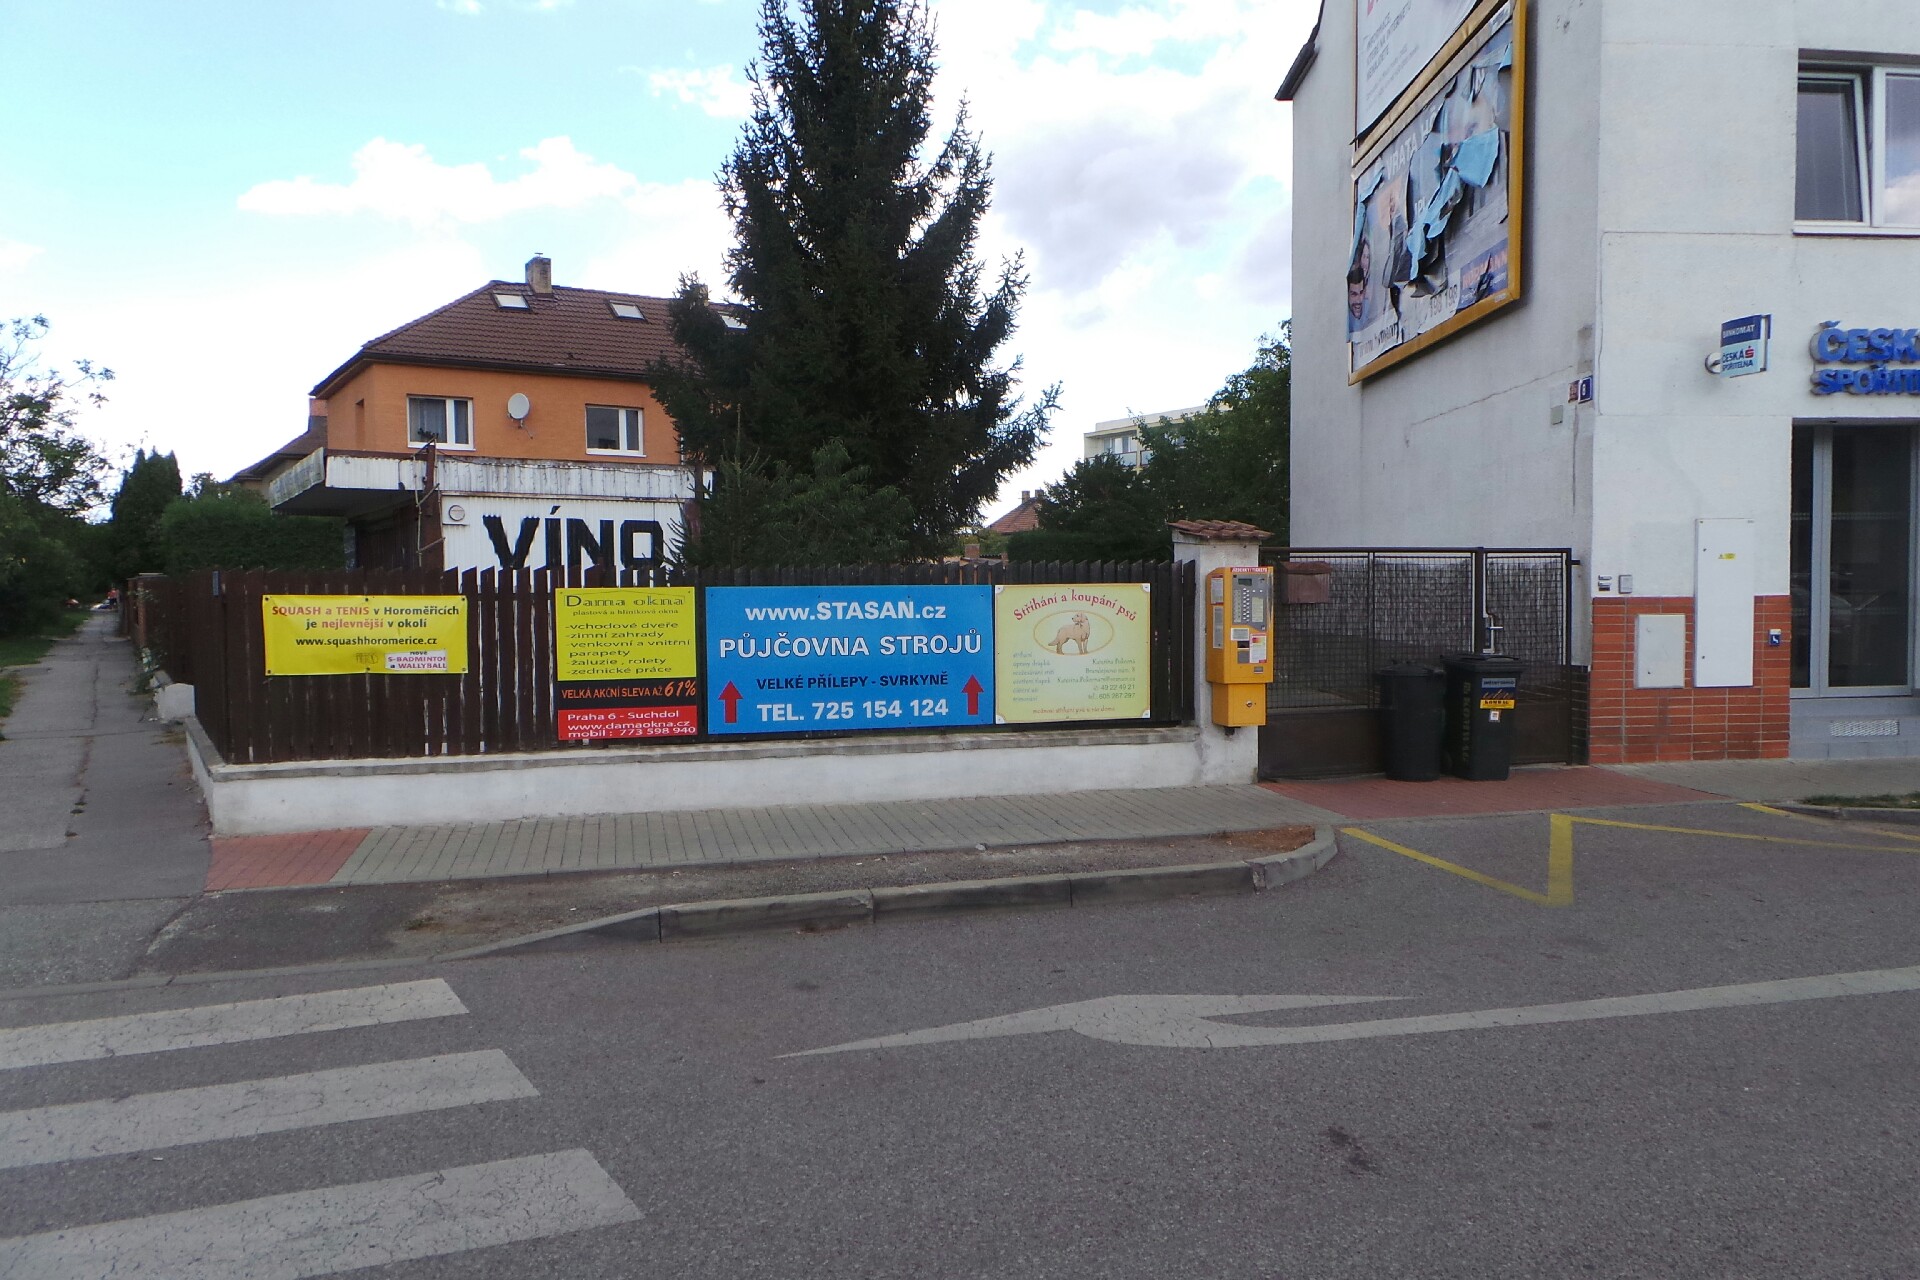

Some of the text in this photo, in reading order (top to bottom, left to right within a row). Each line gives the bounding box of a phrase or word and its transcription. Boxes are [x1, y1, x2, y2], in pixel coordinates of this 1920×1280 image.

[482, 505, 664, 571] VÍNO
[566, 595, 684, 607] Dama okna
[1013, 588, 1137, 621] Stříhání a koupání psů
[272, 606, 321, 616] SQUASH
[336, 606, 370, 615] TENIS
[384, 605, 460, 616] Horoměřicích
[745, 601, 947, 621] www.STASAN.cz
[306, 618, 427, 630] je nejlevnější v okolí
[611, 631, 664, 639] zahrady
[296, 636, 438, 648] www.squashhoromerice.cz
[719, 628, 982, 658] PŮJČOVNA STROJŮ
[569, 649, 630, 658] parapety
[628, 657, 667, 665] rolety
[635, 666, 672, 675] práce
[757, 674, 804, 690] VELKÉ
[808, 673, 869, 689] PŘÍLEPY
[880, 671, 948, 686] SVRKYNĚ
[562, 687, 592, 699] VELKÁ
[593, 685, 620, 699] AKČNÍ
[622, 687, 652, 698] SLEVA
[567, 713, 605, 721] Praha
[608, 712, 616, 720] 6
[628, 710, 679, 720] Suchdol
[757, 699, 949, 722] TEL. 725 154 124
[568, 720, 691, 731] www.damaokna.cz
[568, 730, 606, 738] mobil
